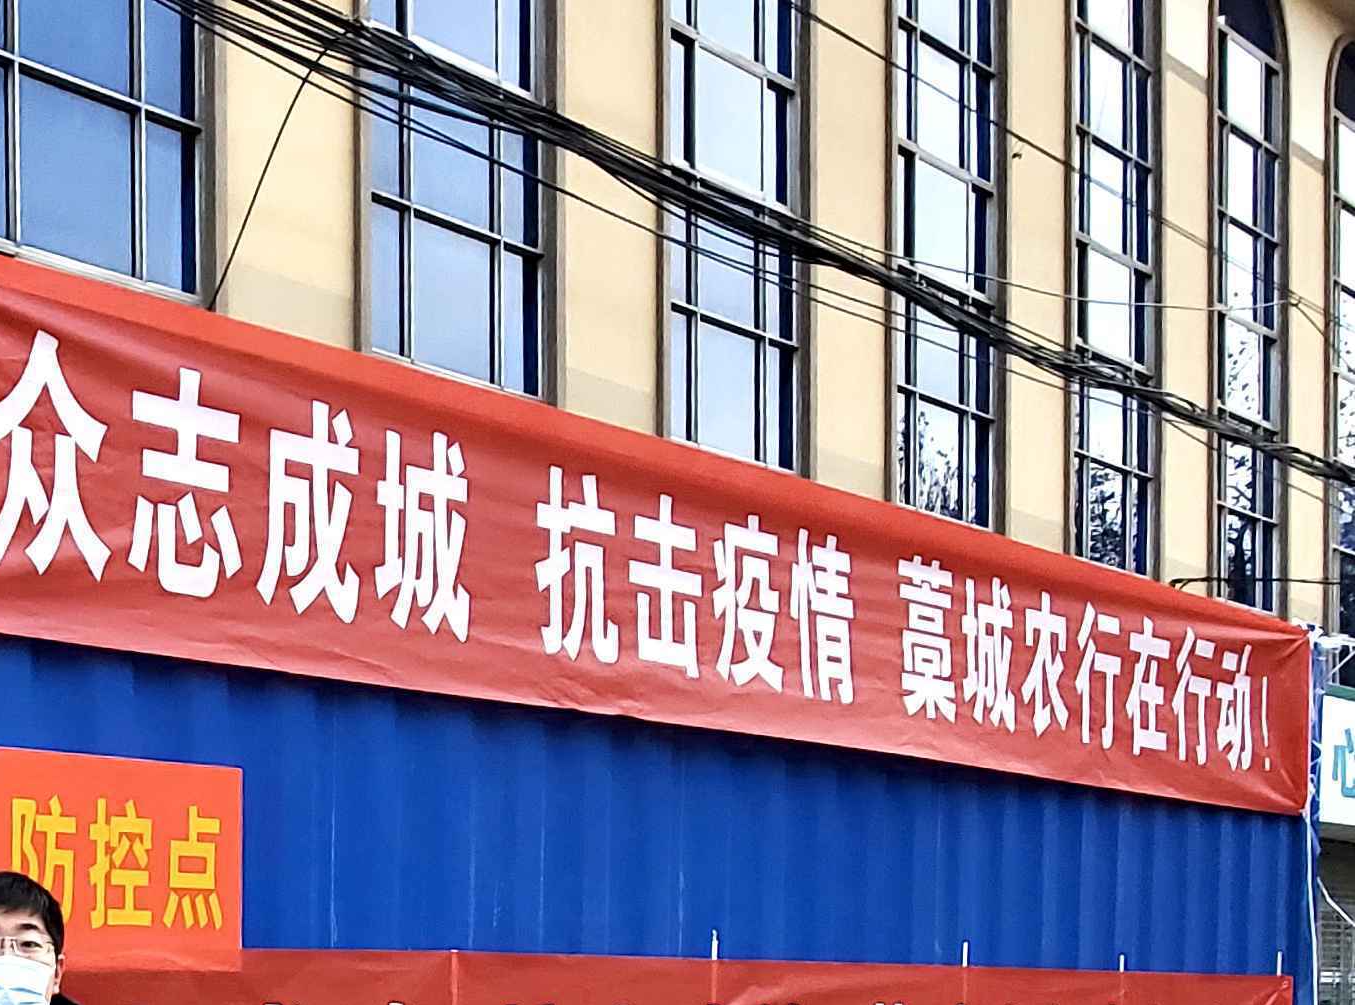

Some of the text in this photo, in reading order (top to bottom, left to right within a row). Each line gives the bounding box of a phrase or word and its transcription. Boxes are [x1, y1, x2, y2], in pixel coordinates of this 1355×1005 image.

[533, 464, 857, 705] 抗击疫情
[10, 793, 224, 930] 防控点
